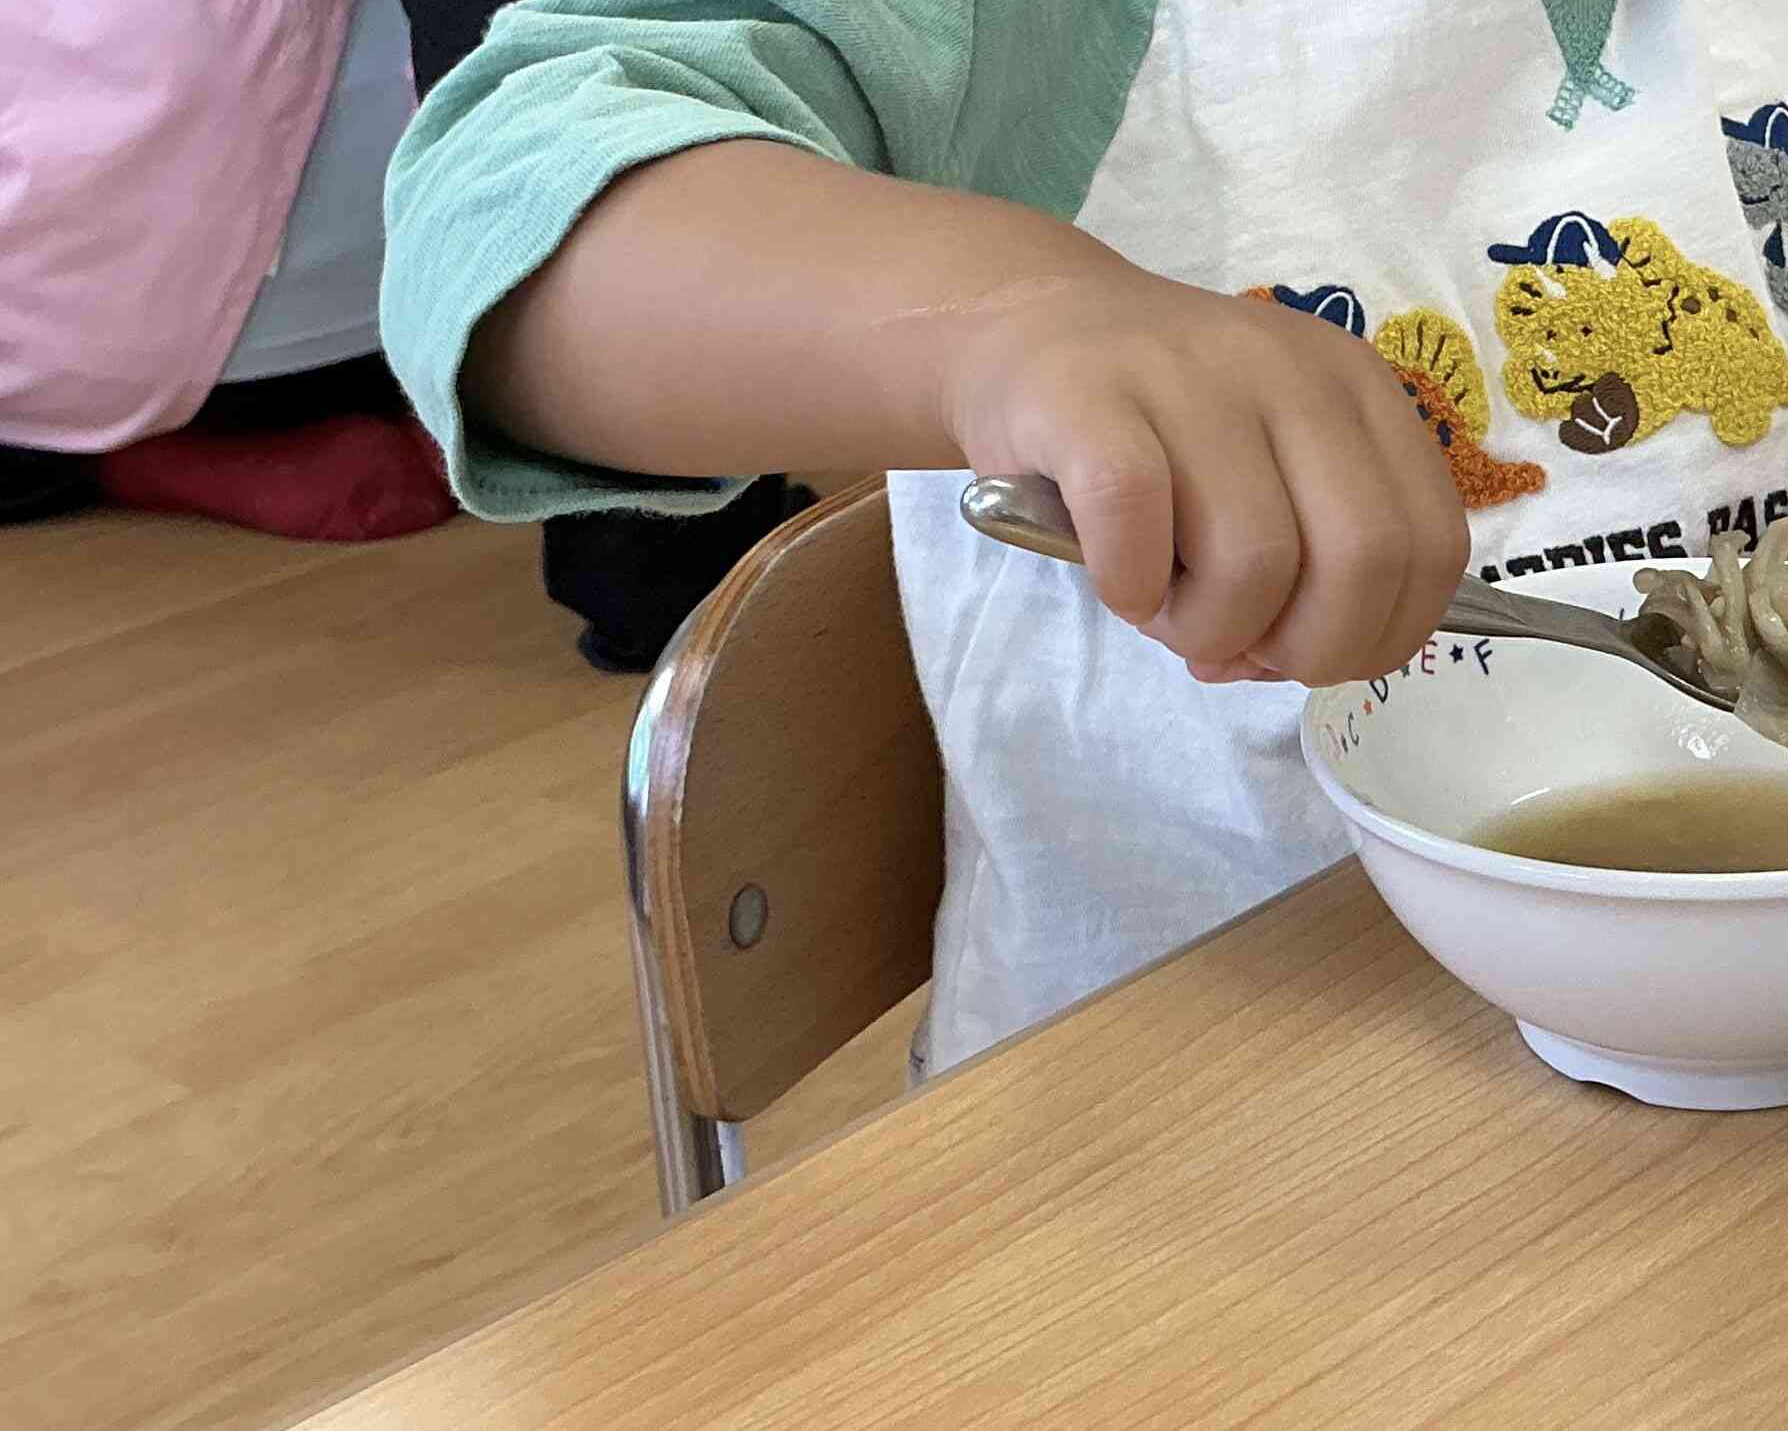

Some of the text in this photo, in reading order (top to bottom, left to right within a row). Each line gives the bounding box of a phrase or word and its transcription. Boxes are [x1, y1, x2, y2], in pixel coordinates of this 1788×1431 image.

[1369, 675, 1388, 704] D
[1421, 640, 1438, 675] E
[1473, 638, 1493, 675] F
